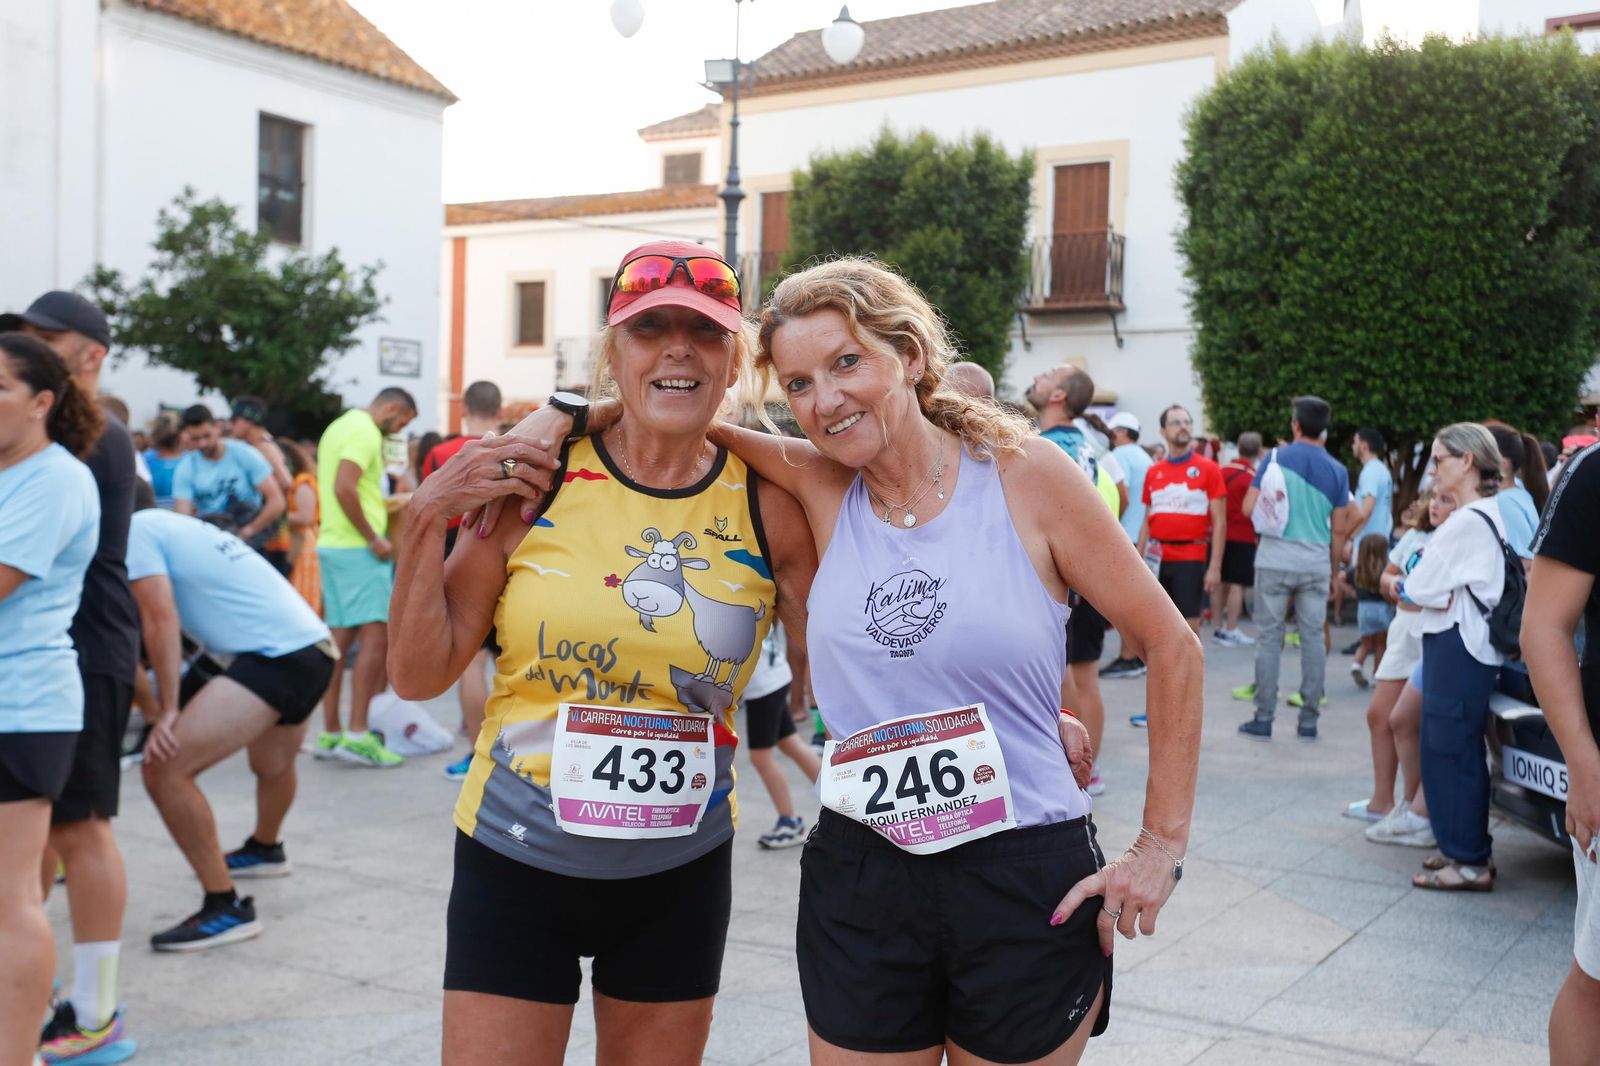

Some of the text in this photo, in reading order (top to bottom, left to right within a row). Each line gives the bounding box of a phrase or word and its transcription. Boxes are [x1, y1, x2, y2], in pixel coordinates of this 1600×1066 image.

[704, 528, 742, 541] SPALL
[865, 577, 947, 614] Kalima
[865, 601, 947, 648] VALDEVAQUEROS
[580, 710, 622, 726] CARRERA
[622, 714, 672, 731] NOCTURNA
[672, 718, 706, 733] SOLIDARIA
[611, 728, 632, 736] corre
[633, 731, 646, 739] por
[647, 729, 654, 737] la
[840, 733, 875, 753] CARRERA
[873, 721, 926, 744] NOCTURNA
[925, 712, 979, 733] SOLIDARIA
[866, 744, 886, 754] corre
[887, 742, 900, 752] por
[909, 734, 939, 747] igualdad
[592, 745, 686, 795] 433
[1512, 754, 1569, 794] IONIQ 5
[862, 749, 965, 815] 246
[579, 802, 646, 822] AVATEL
[901, 794, 979, 821] FERNANDEZ
[936, 808, 974, 824] FIBRA ÓPTICA
[938, 817, 968, 830] TELEFONÍA
[940, 824, 971, 838] TELEVISIÓN
[908, 835, 935, 845] TELECOM
